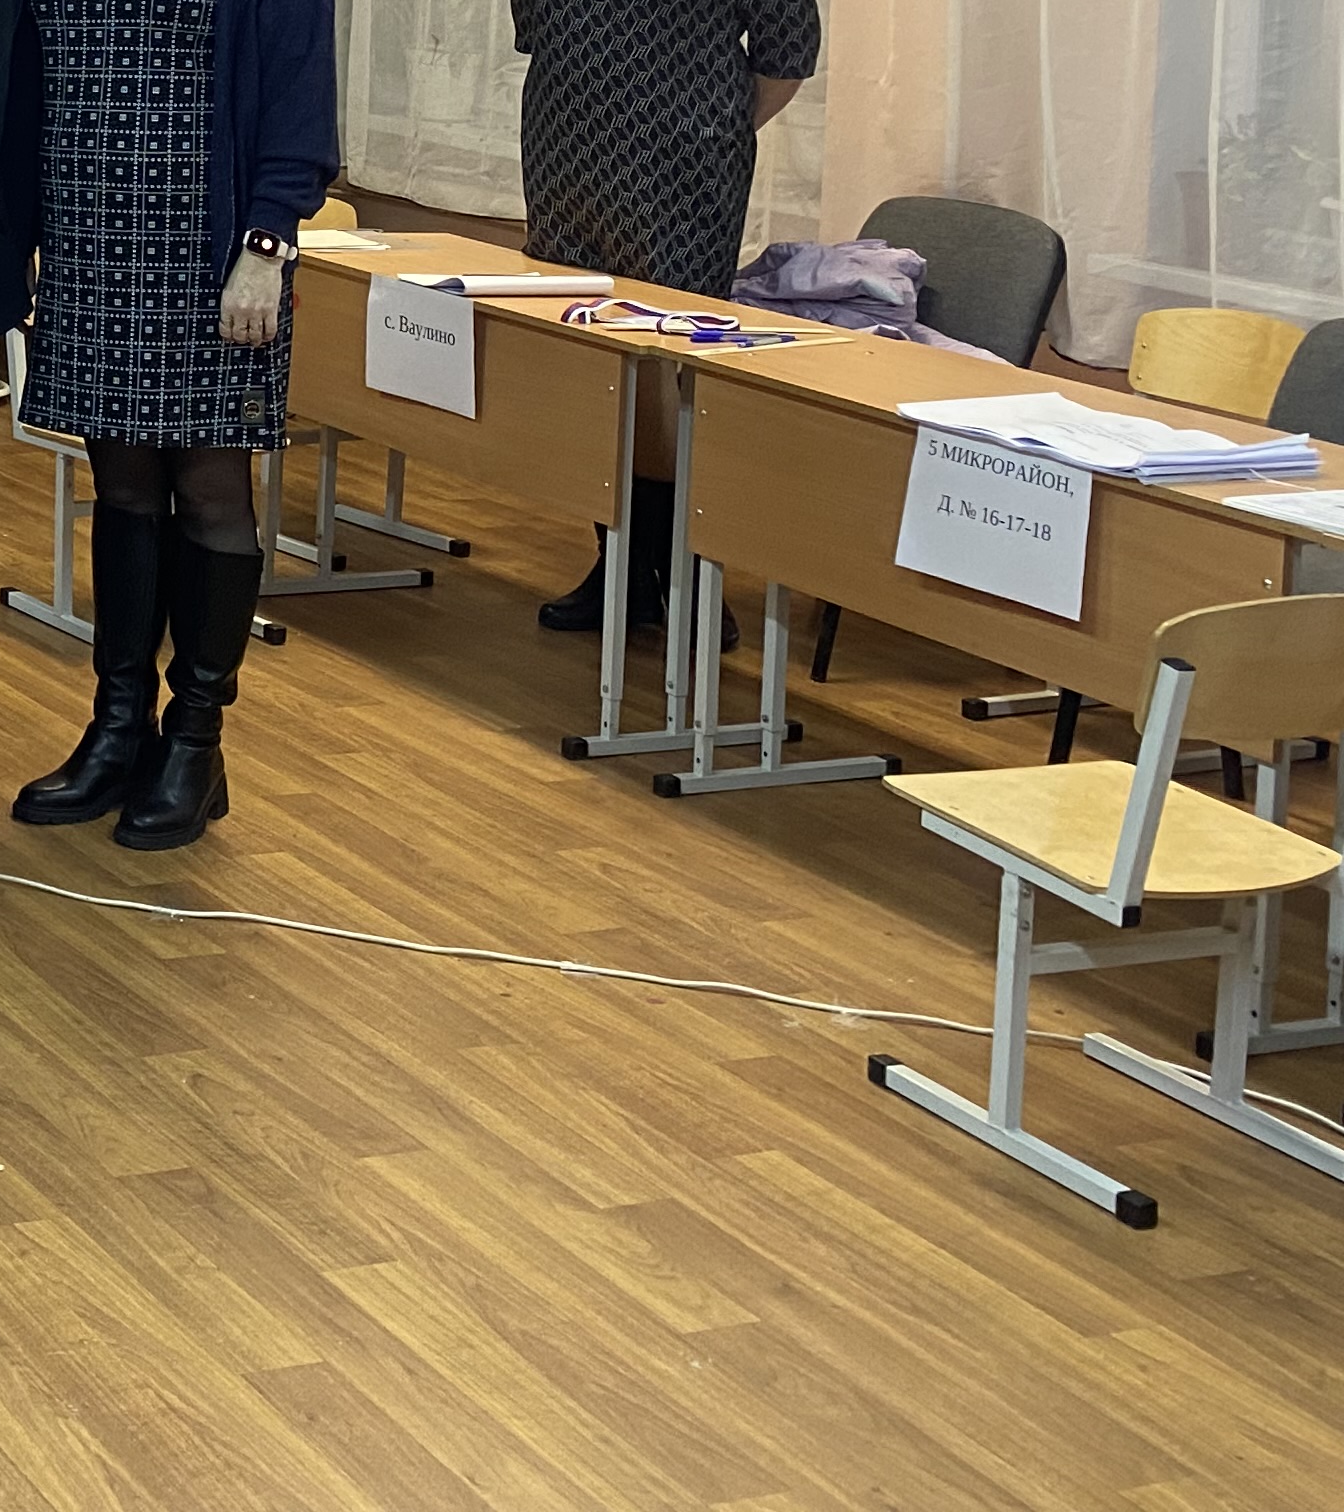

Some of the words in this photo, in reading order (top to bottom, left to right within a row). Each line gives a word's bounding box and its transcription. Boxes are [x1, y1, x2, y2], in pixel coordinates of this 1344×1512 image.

[384, 315, 395, 330] с.
[399, 315, 456, 346] Ваулино
[928, 439, 938, 456] 5
[940, 442, 1074, 498] МИКРОРАЙОН,
[937, 494, 955, 515] Д.
[959, 499, 977, 520] №
[982, 506, 1052, 542] 16-17-18
